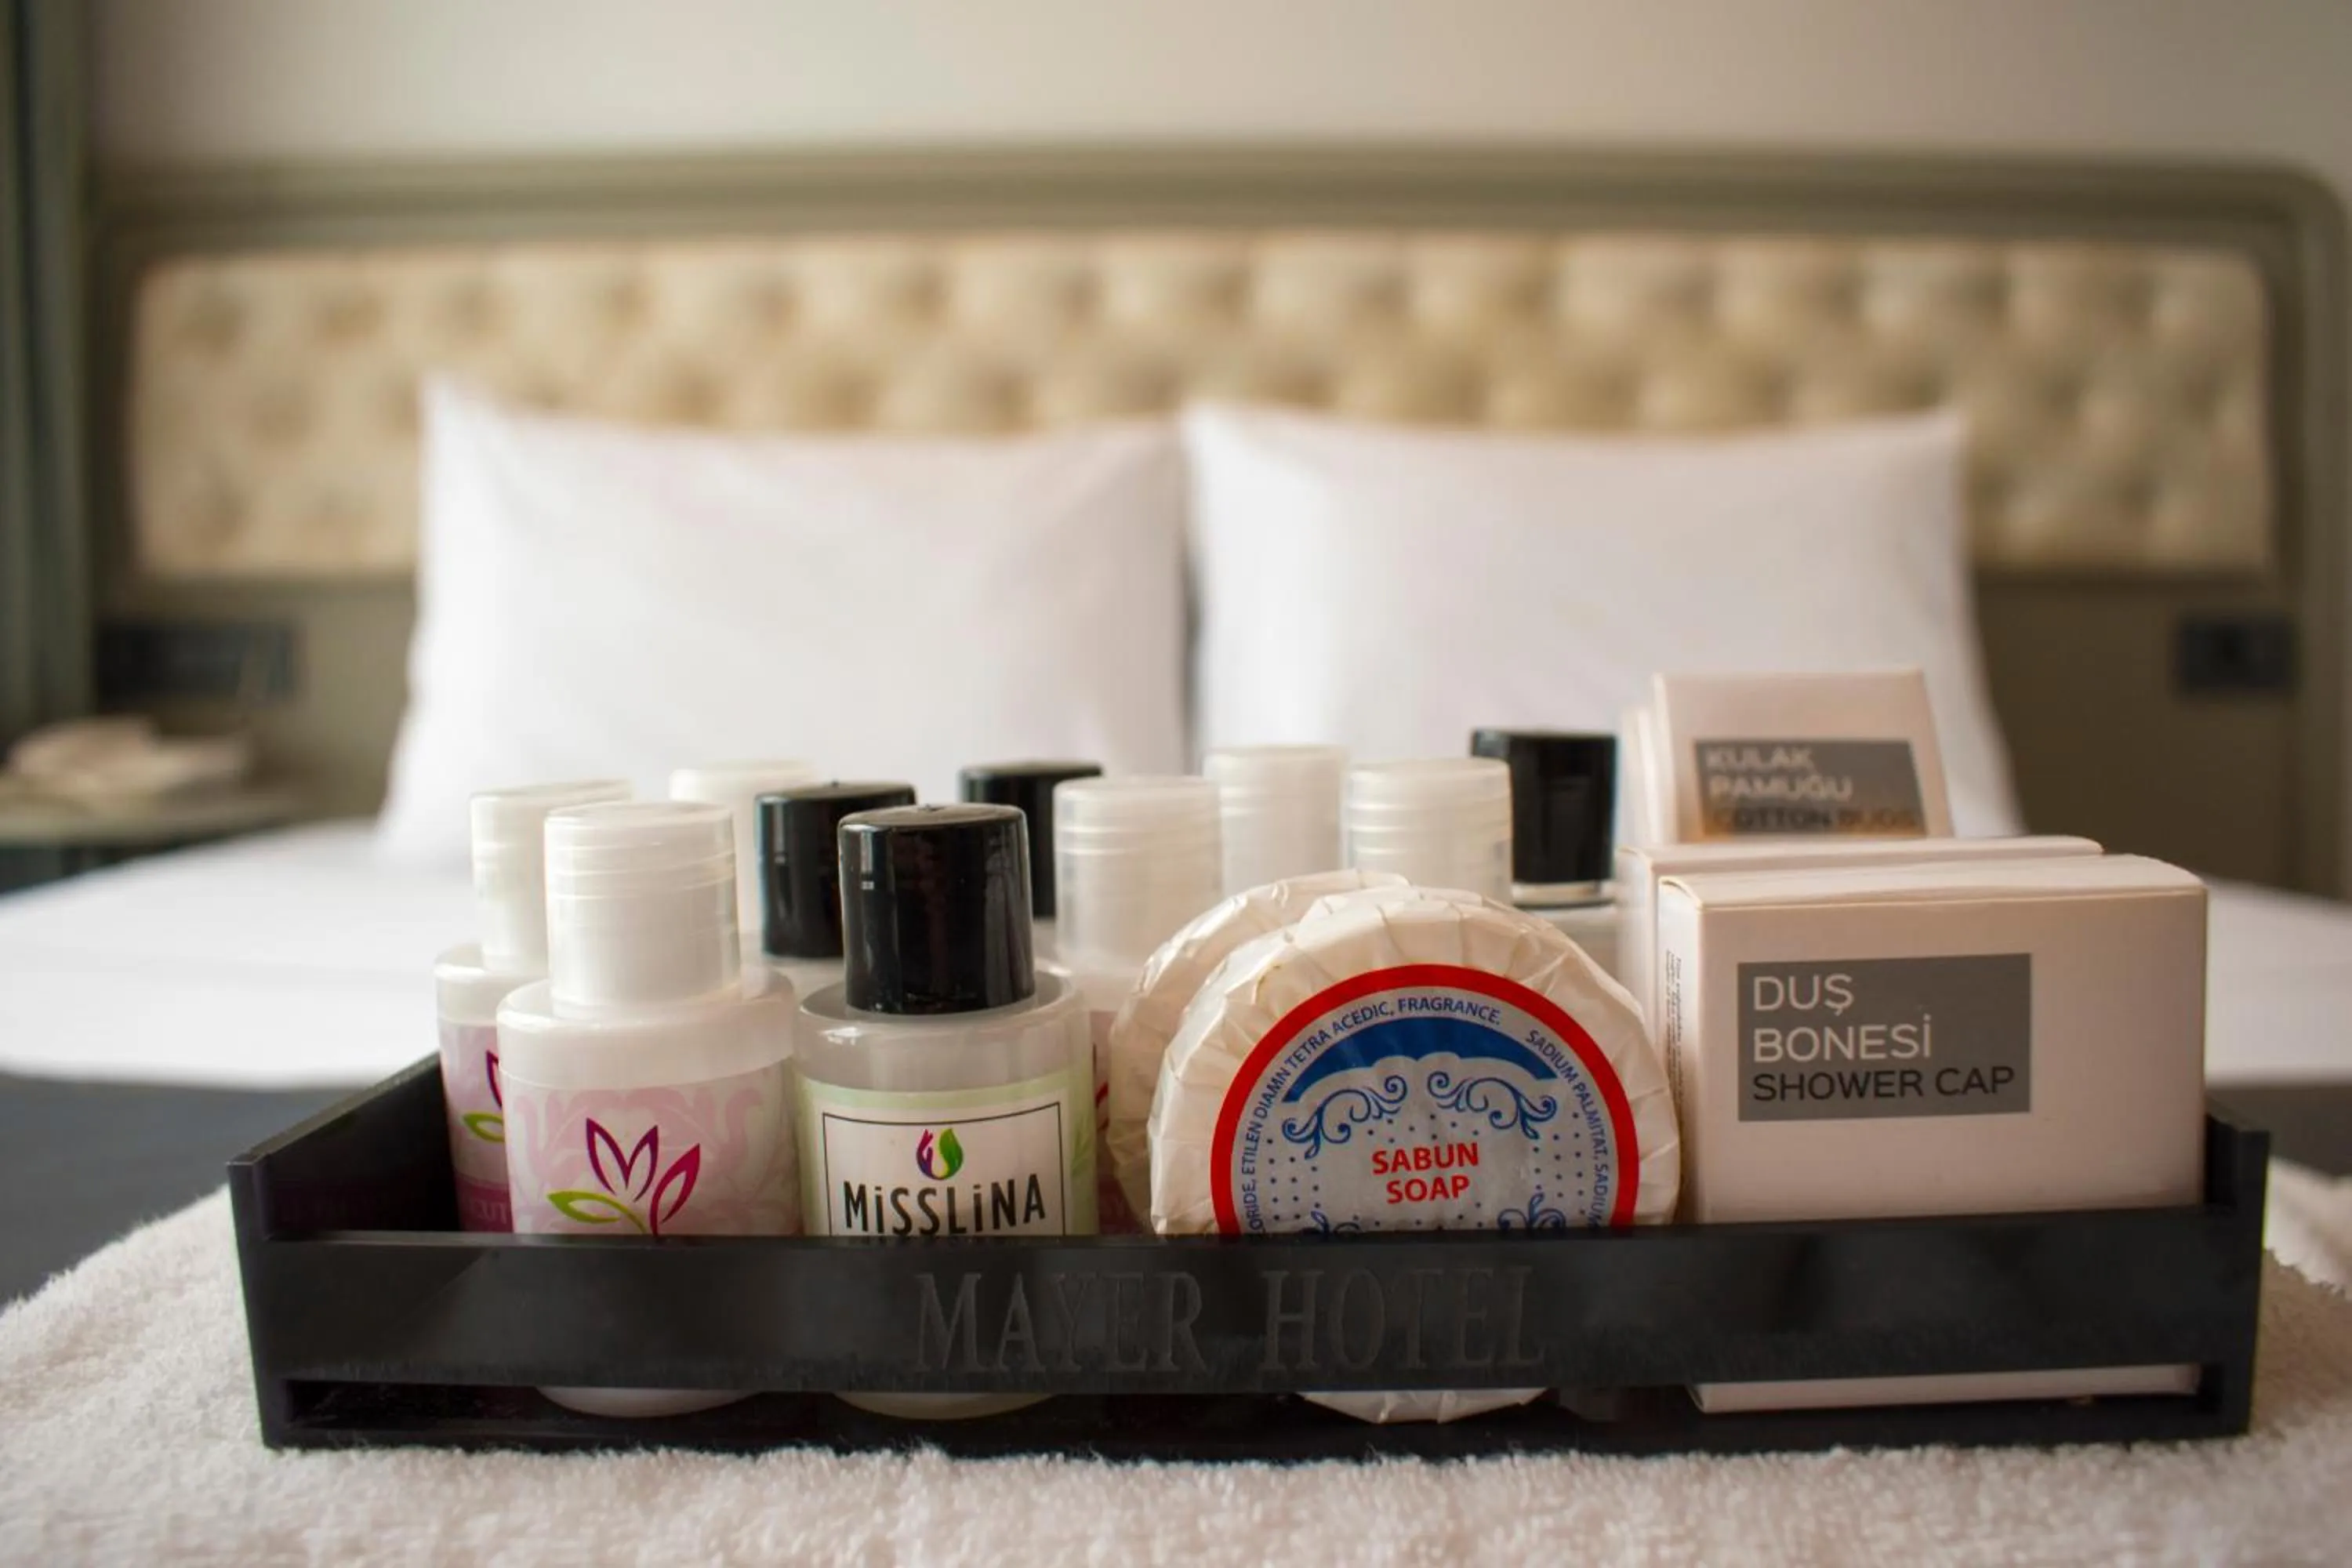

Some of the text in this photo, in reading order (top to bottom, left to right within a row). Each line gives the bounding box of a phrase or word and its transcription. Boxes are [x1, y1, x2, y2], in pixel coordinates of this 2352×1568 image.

[1705, 746, 1817, 771] KULAK
[1753, 974, 1855, 1016] DUŞ
[1525, 1029, 1579, 1083] SADIUM
[1753, 1014, 1932, 1062] BONESİ
[1242, 1121, 1264, 1174] ETILEN
[1253, 1067, 1291, 1119] DIAMN
[1284, 1029, 1331, 1069] TETRA
[1331, 1000, 1395, 1036] ACEDIC,
[1397, 996, 1502, 1025] FRAGRANCE.
[1753, 1065, 2015, 1102] SHOWER CAP
[1371, 1142, 1479, 1174] SABUN
[1385, 1176, 1471, 1205] SOAP
[913, 1265, 1547, 1373] MAYER HOTEL
